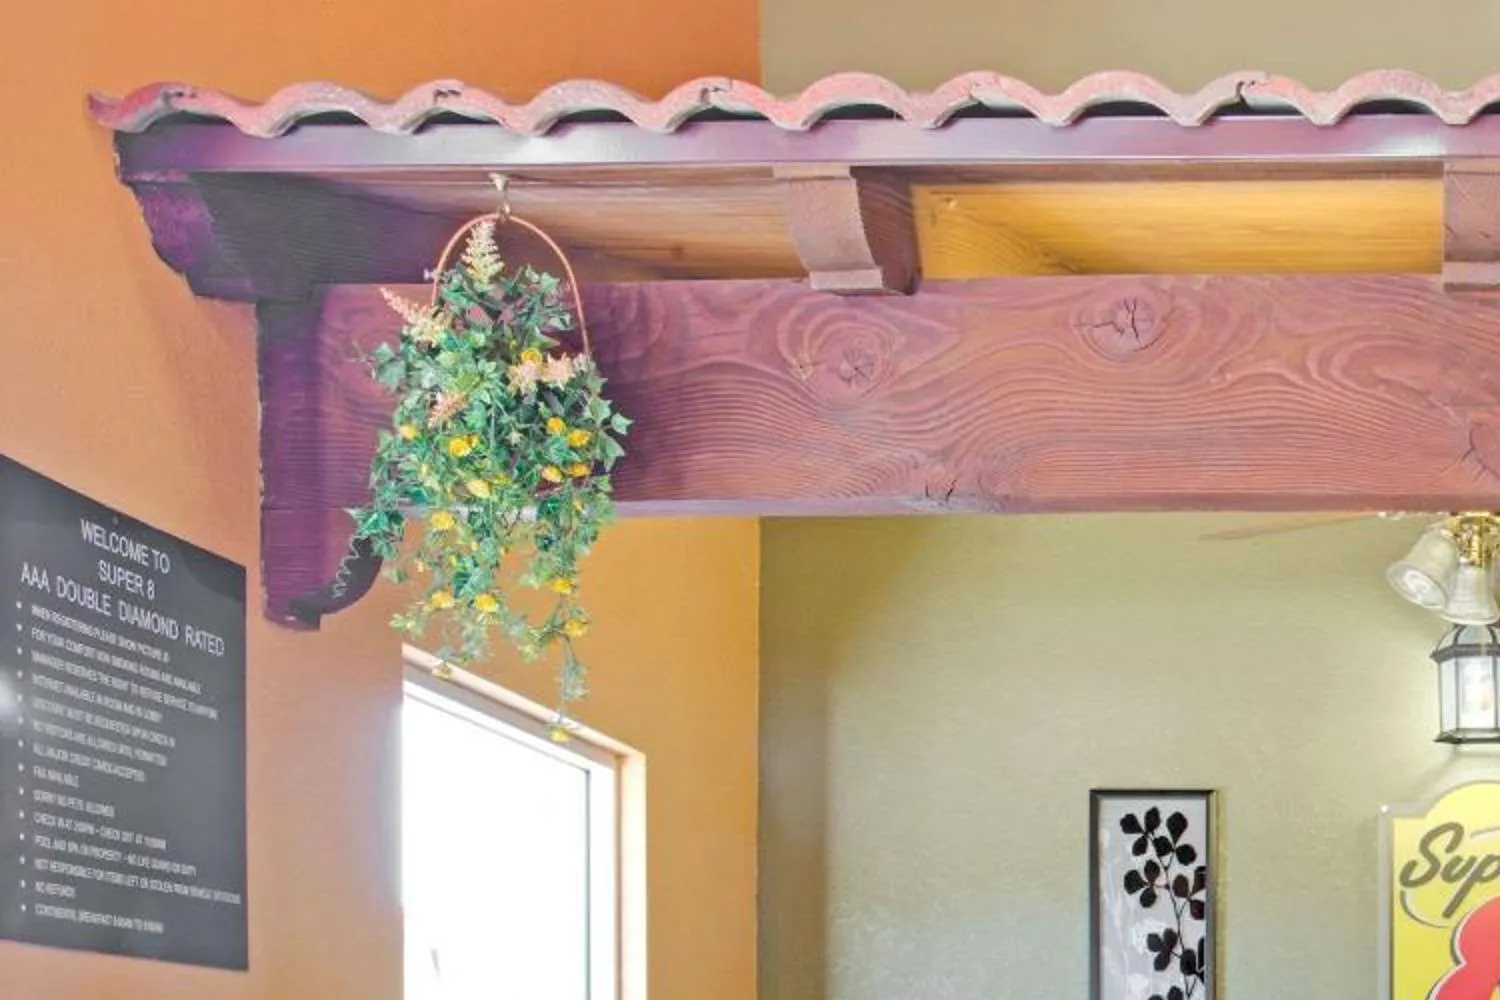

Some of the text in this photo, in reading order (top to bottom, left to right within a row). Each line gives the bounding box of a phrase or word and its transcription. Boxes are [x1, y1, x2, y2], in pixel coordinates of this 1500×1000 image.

[80, 518, 171, 575] WELCOME TO
[97, 559, 155, 600] SUPER 8
[21, 562, 225, 657] AAA DOUBLE DIAMOND RATED
